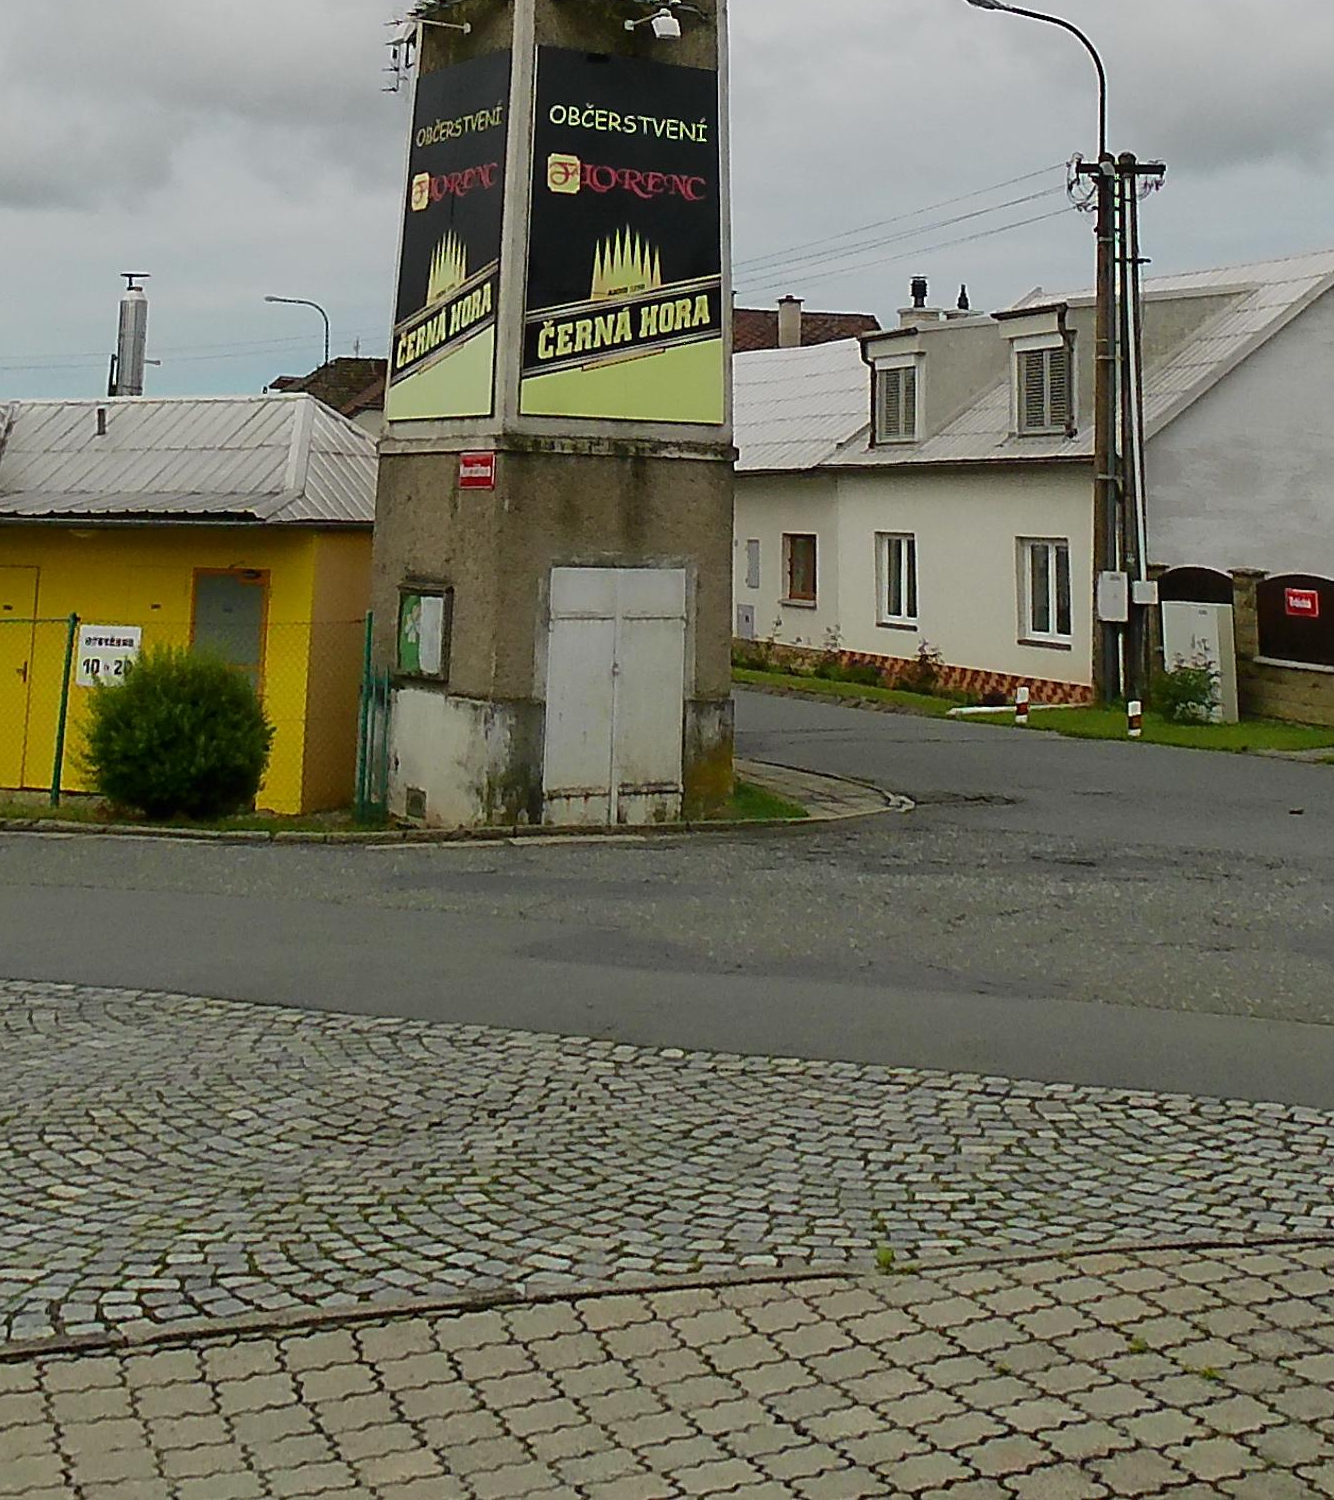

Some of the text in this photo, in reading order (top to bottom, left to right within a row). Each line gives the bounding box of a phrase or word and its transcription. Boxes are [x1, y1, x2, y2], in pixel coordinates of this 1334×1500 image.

[416, 100, 503, 147] OBČERSTVENÍ
[549, 102, 708, 143] OBČERSTVENÍ
[549, 160, 707, 201] FLORENC
[396, 281, 491, 368] ČERNÁ HORA
[537, 294, 710, 359] ČERNÁ HORA
[82, 658, 100, 675] 10
